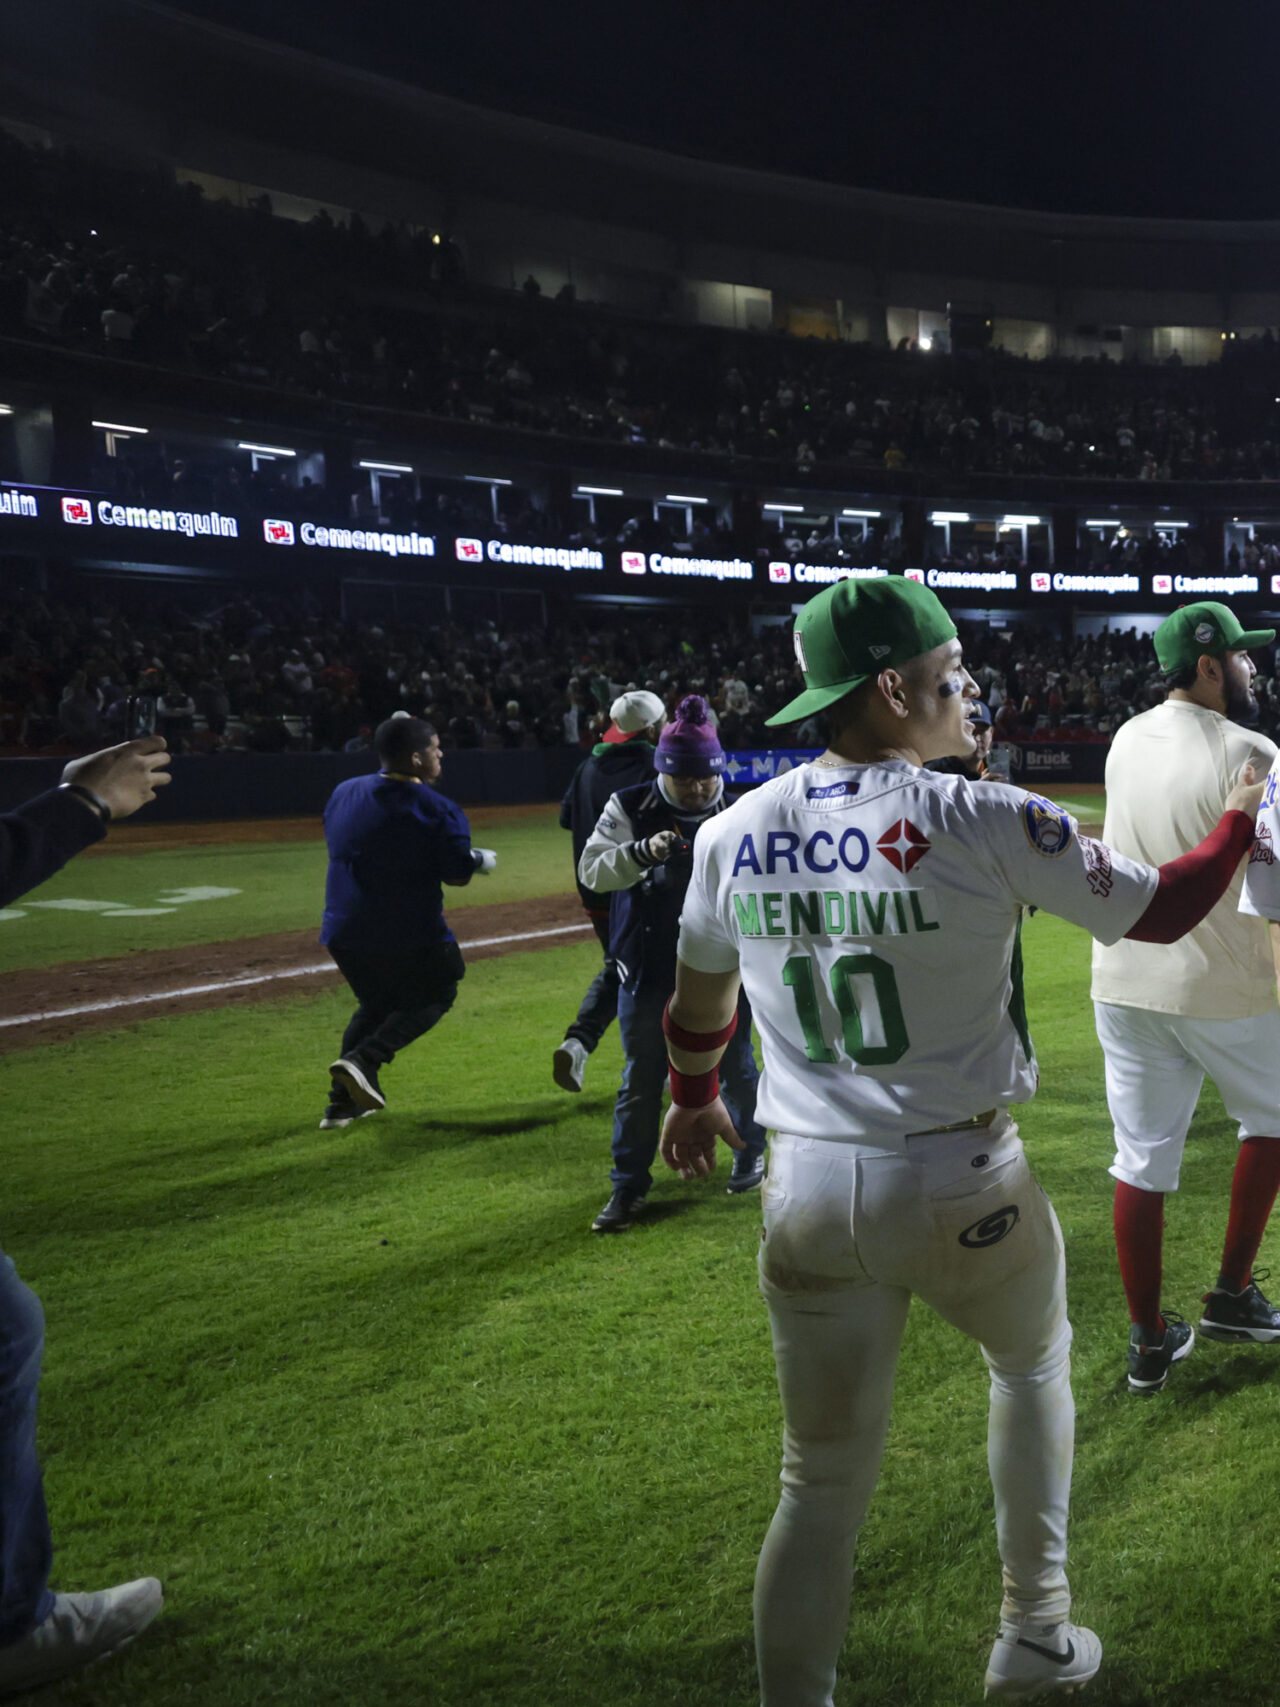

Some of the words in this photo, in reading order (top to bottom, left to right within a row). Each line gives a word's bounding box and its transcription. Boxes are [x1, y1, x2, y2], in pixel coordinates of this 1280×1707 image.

[98, 501, 238, 537] Cemenquin
[301, 523, 435, 556] Cemenquin
[488, 540, 603, 570] Cemenquin
[650, 553, 753, 580] Cemenquin
[733, 827, 870, 877] ARCO
[734, 892, 940, 936] MENDIVIL
[782, 953, 911, 1066] 10
